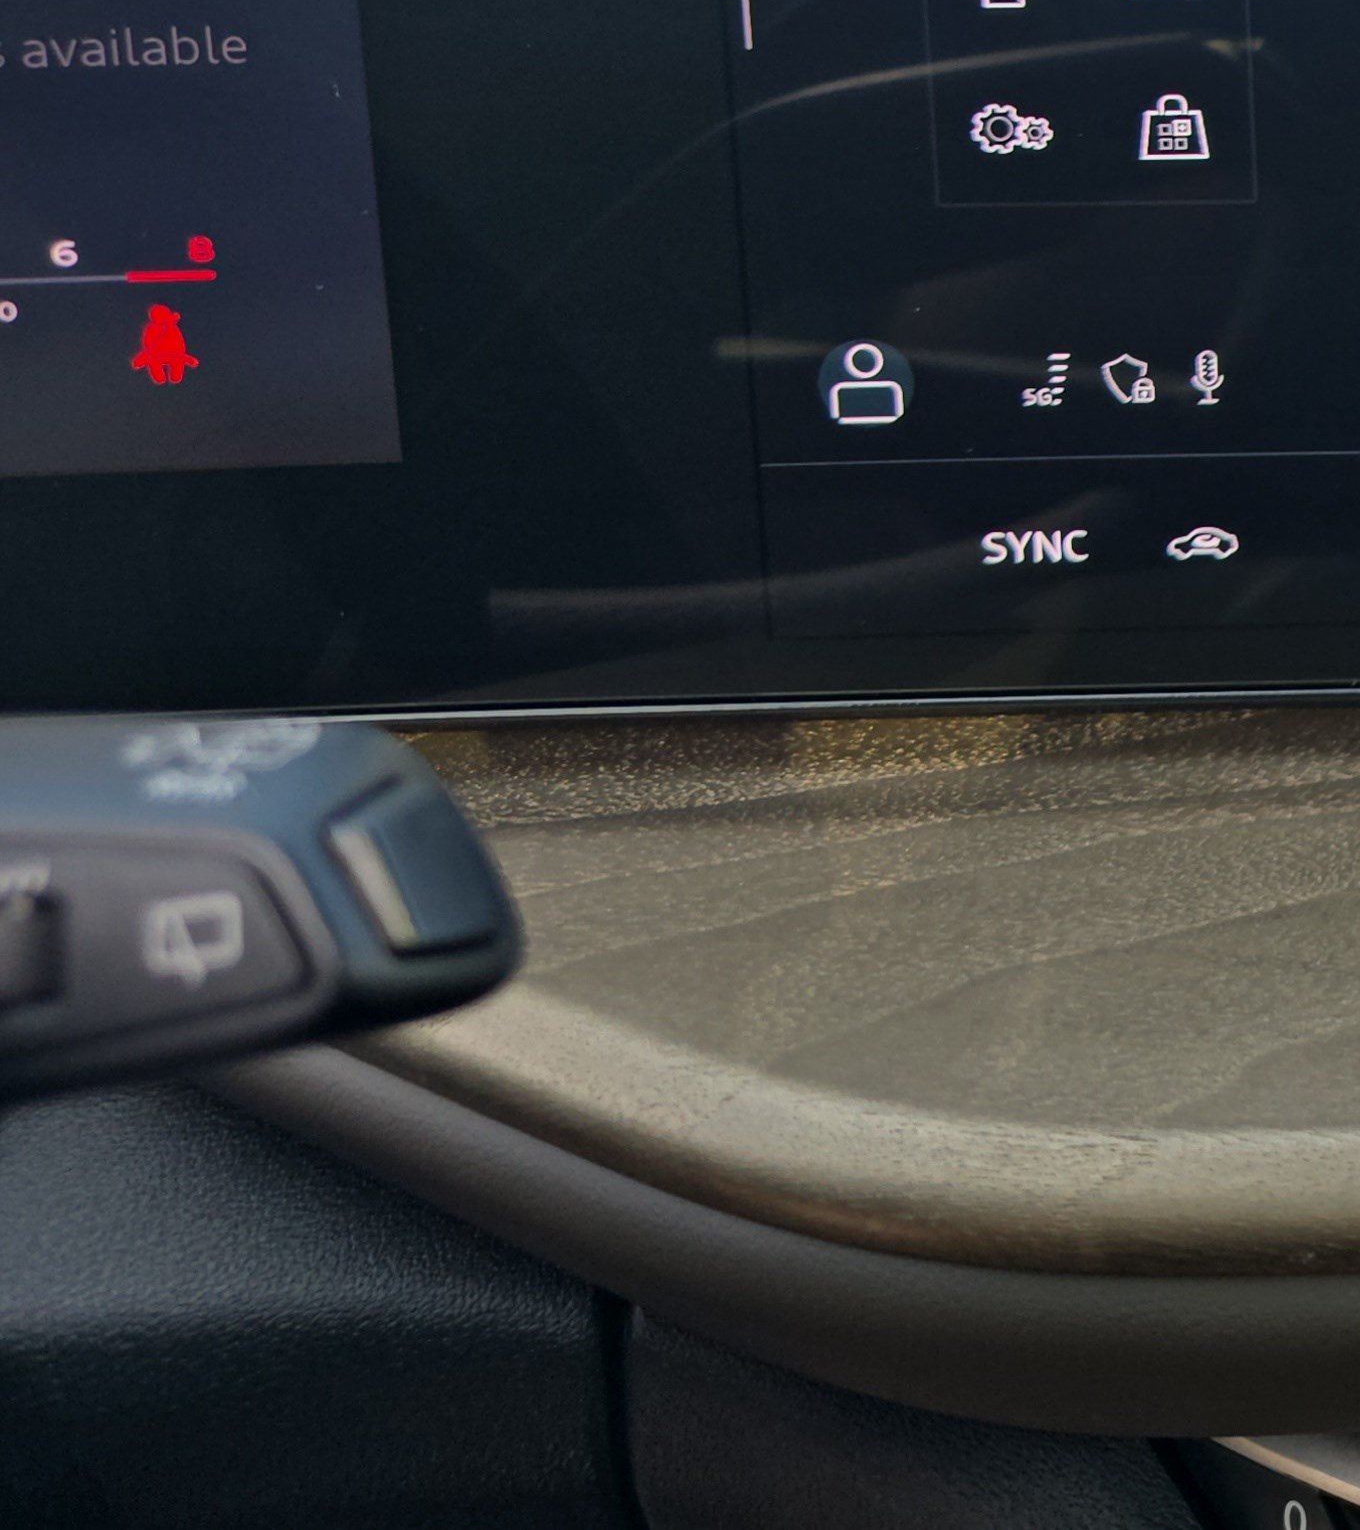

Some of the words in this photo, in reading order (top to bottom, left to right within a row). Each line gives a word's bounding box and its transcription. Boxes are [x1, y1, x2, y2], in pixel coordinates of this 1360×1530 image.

[22, 25, 247, 69] available
[49, 239, 79, 268] 6
[1021, 387, 1053, 407] 5G
[980, 529, 1090, 565] SYNC
